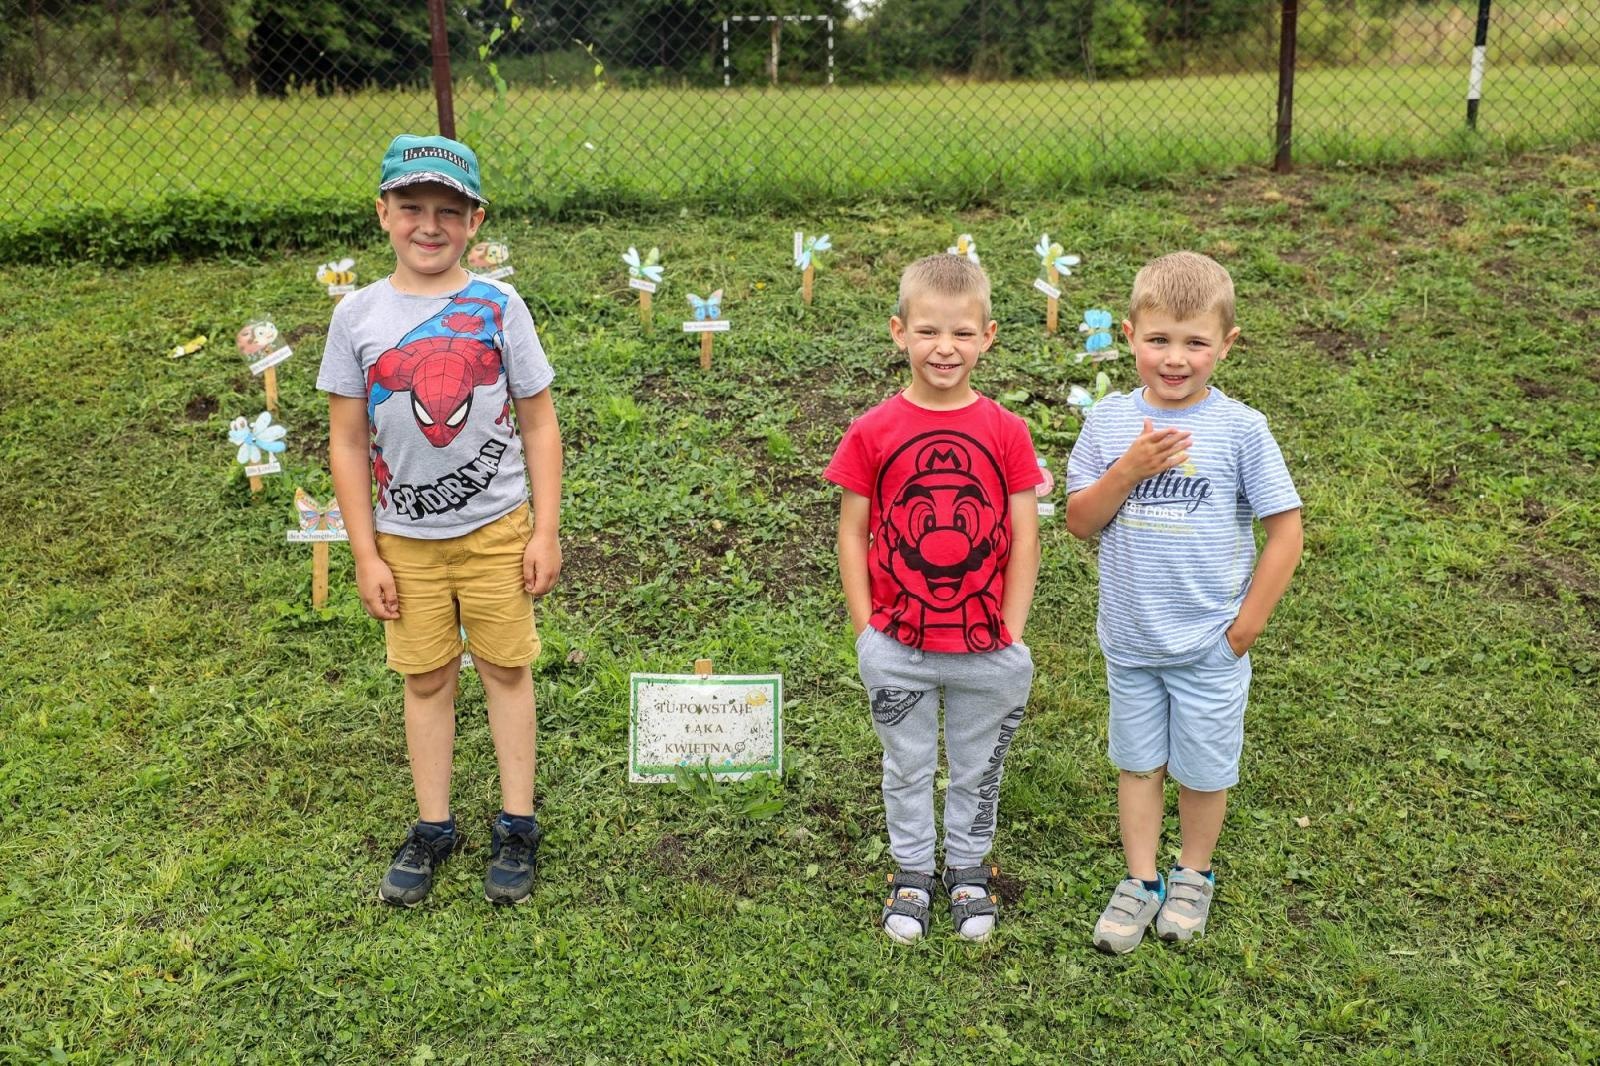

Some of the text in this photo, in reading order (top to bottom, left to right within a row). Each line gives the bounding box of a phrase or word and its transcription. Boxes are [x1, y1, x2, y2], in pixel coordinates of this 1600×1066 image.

[925, 447, 962, 470] M
[1145, 505, 1185, 520] COAST
[659, 703, 753, 716] TU POWSTAJE
